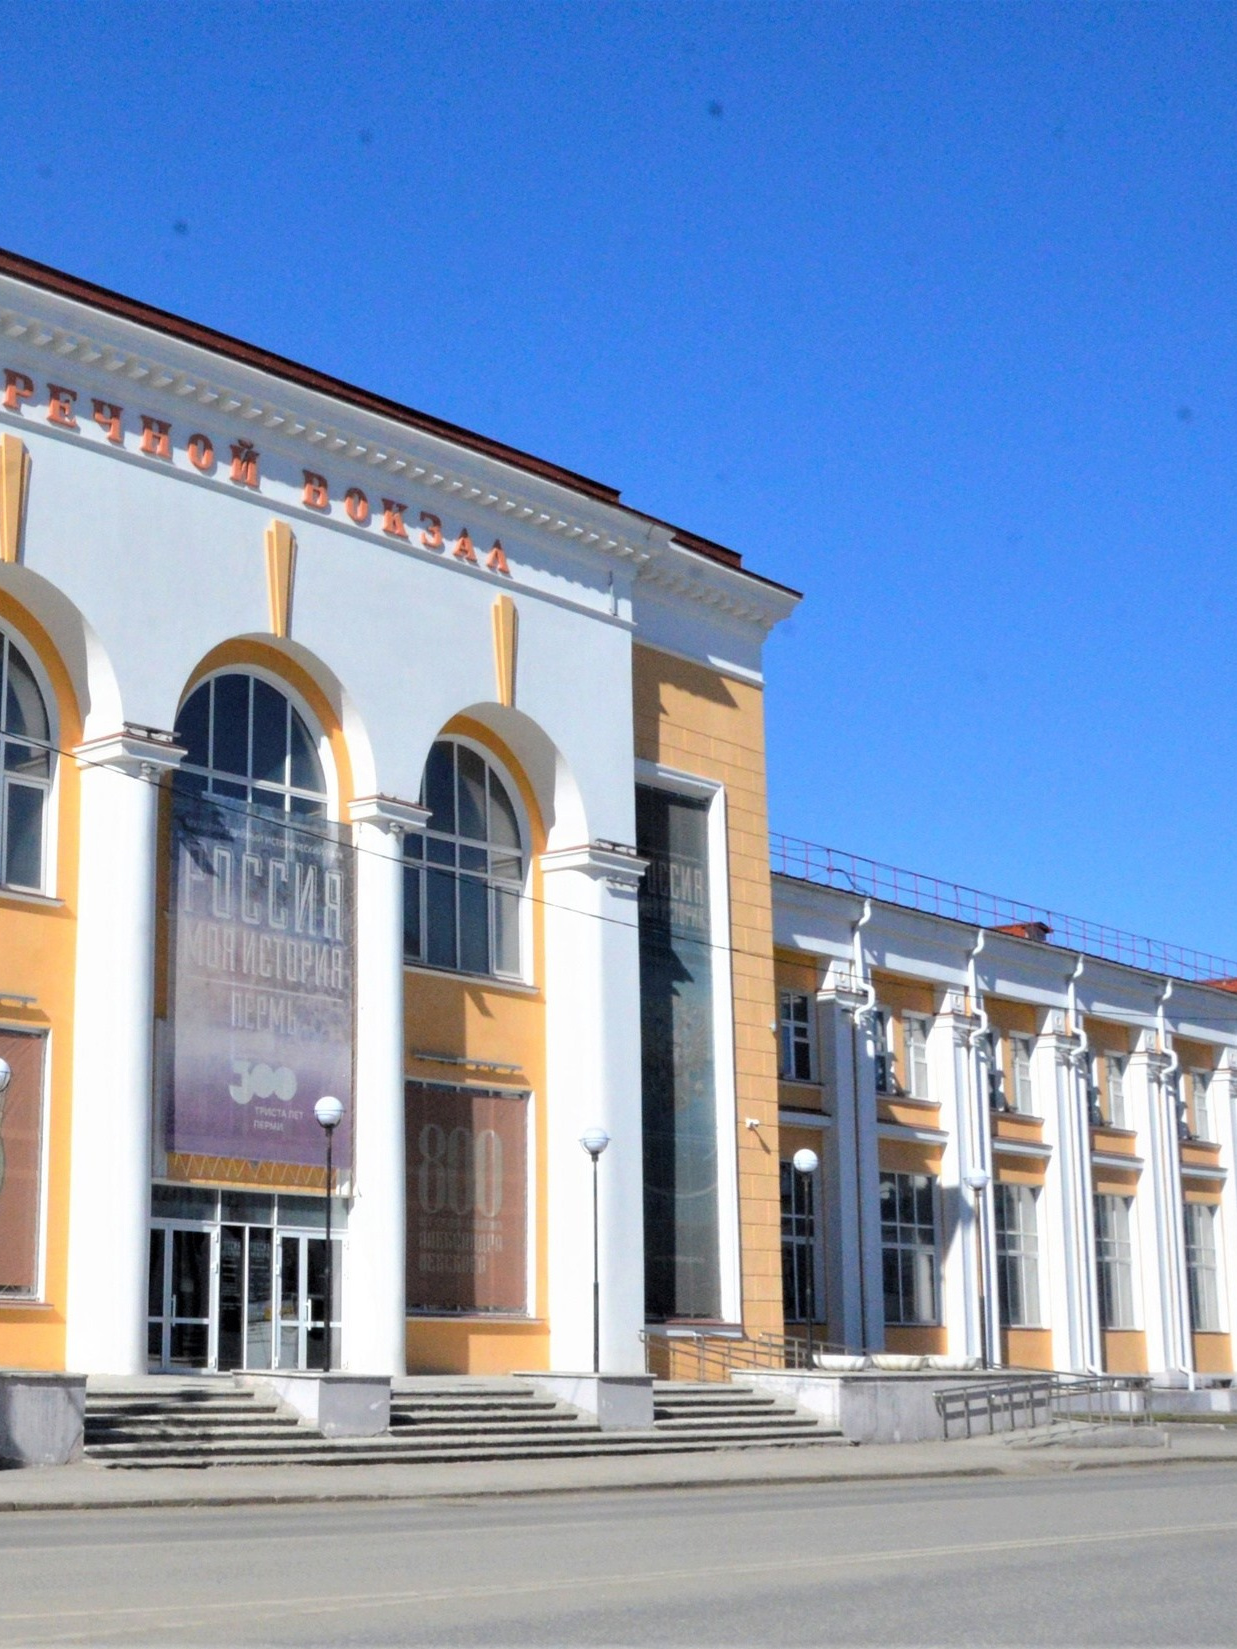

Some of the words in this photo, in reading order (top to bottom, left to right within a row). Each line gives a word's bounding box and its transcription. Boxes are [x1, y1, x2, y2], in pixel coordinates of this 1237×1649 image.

[3, 368, 260, 488] РЕЧНОЙ
[302, 469, 510, 574] ВОКЗАЛ
[183, 842, 344, 940] РОССИЯ
[184, 919, 236, 971] МОЯ
[243, 931, 342, 989] ИСТОРИЯ
[232, 991, 296, 1035] ПЕРМЬ
[228, 1060, 297, 1105] 300
[419, 1124, 502, 1217] 800
